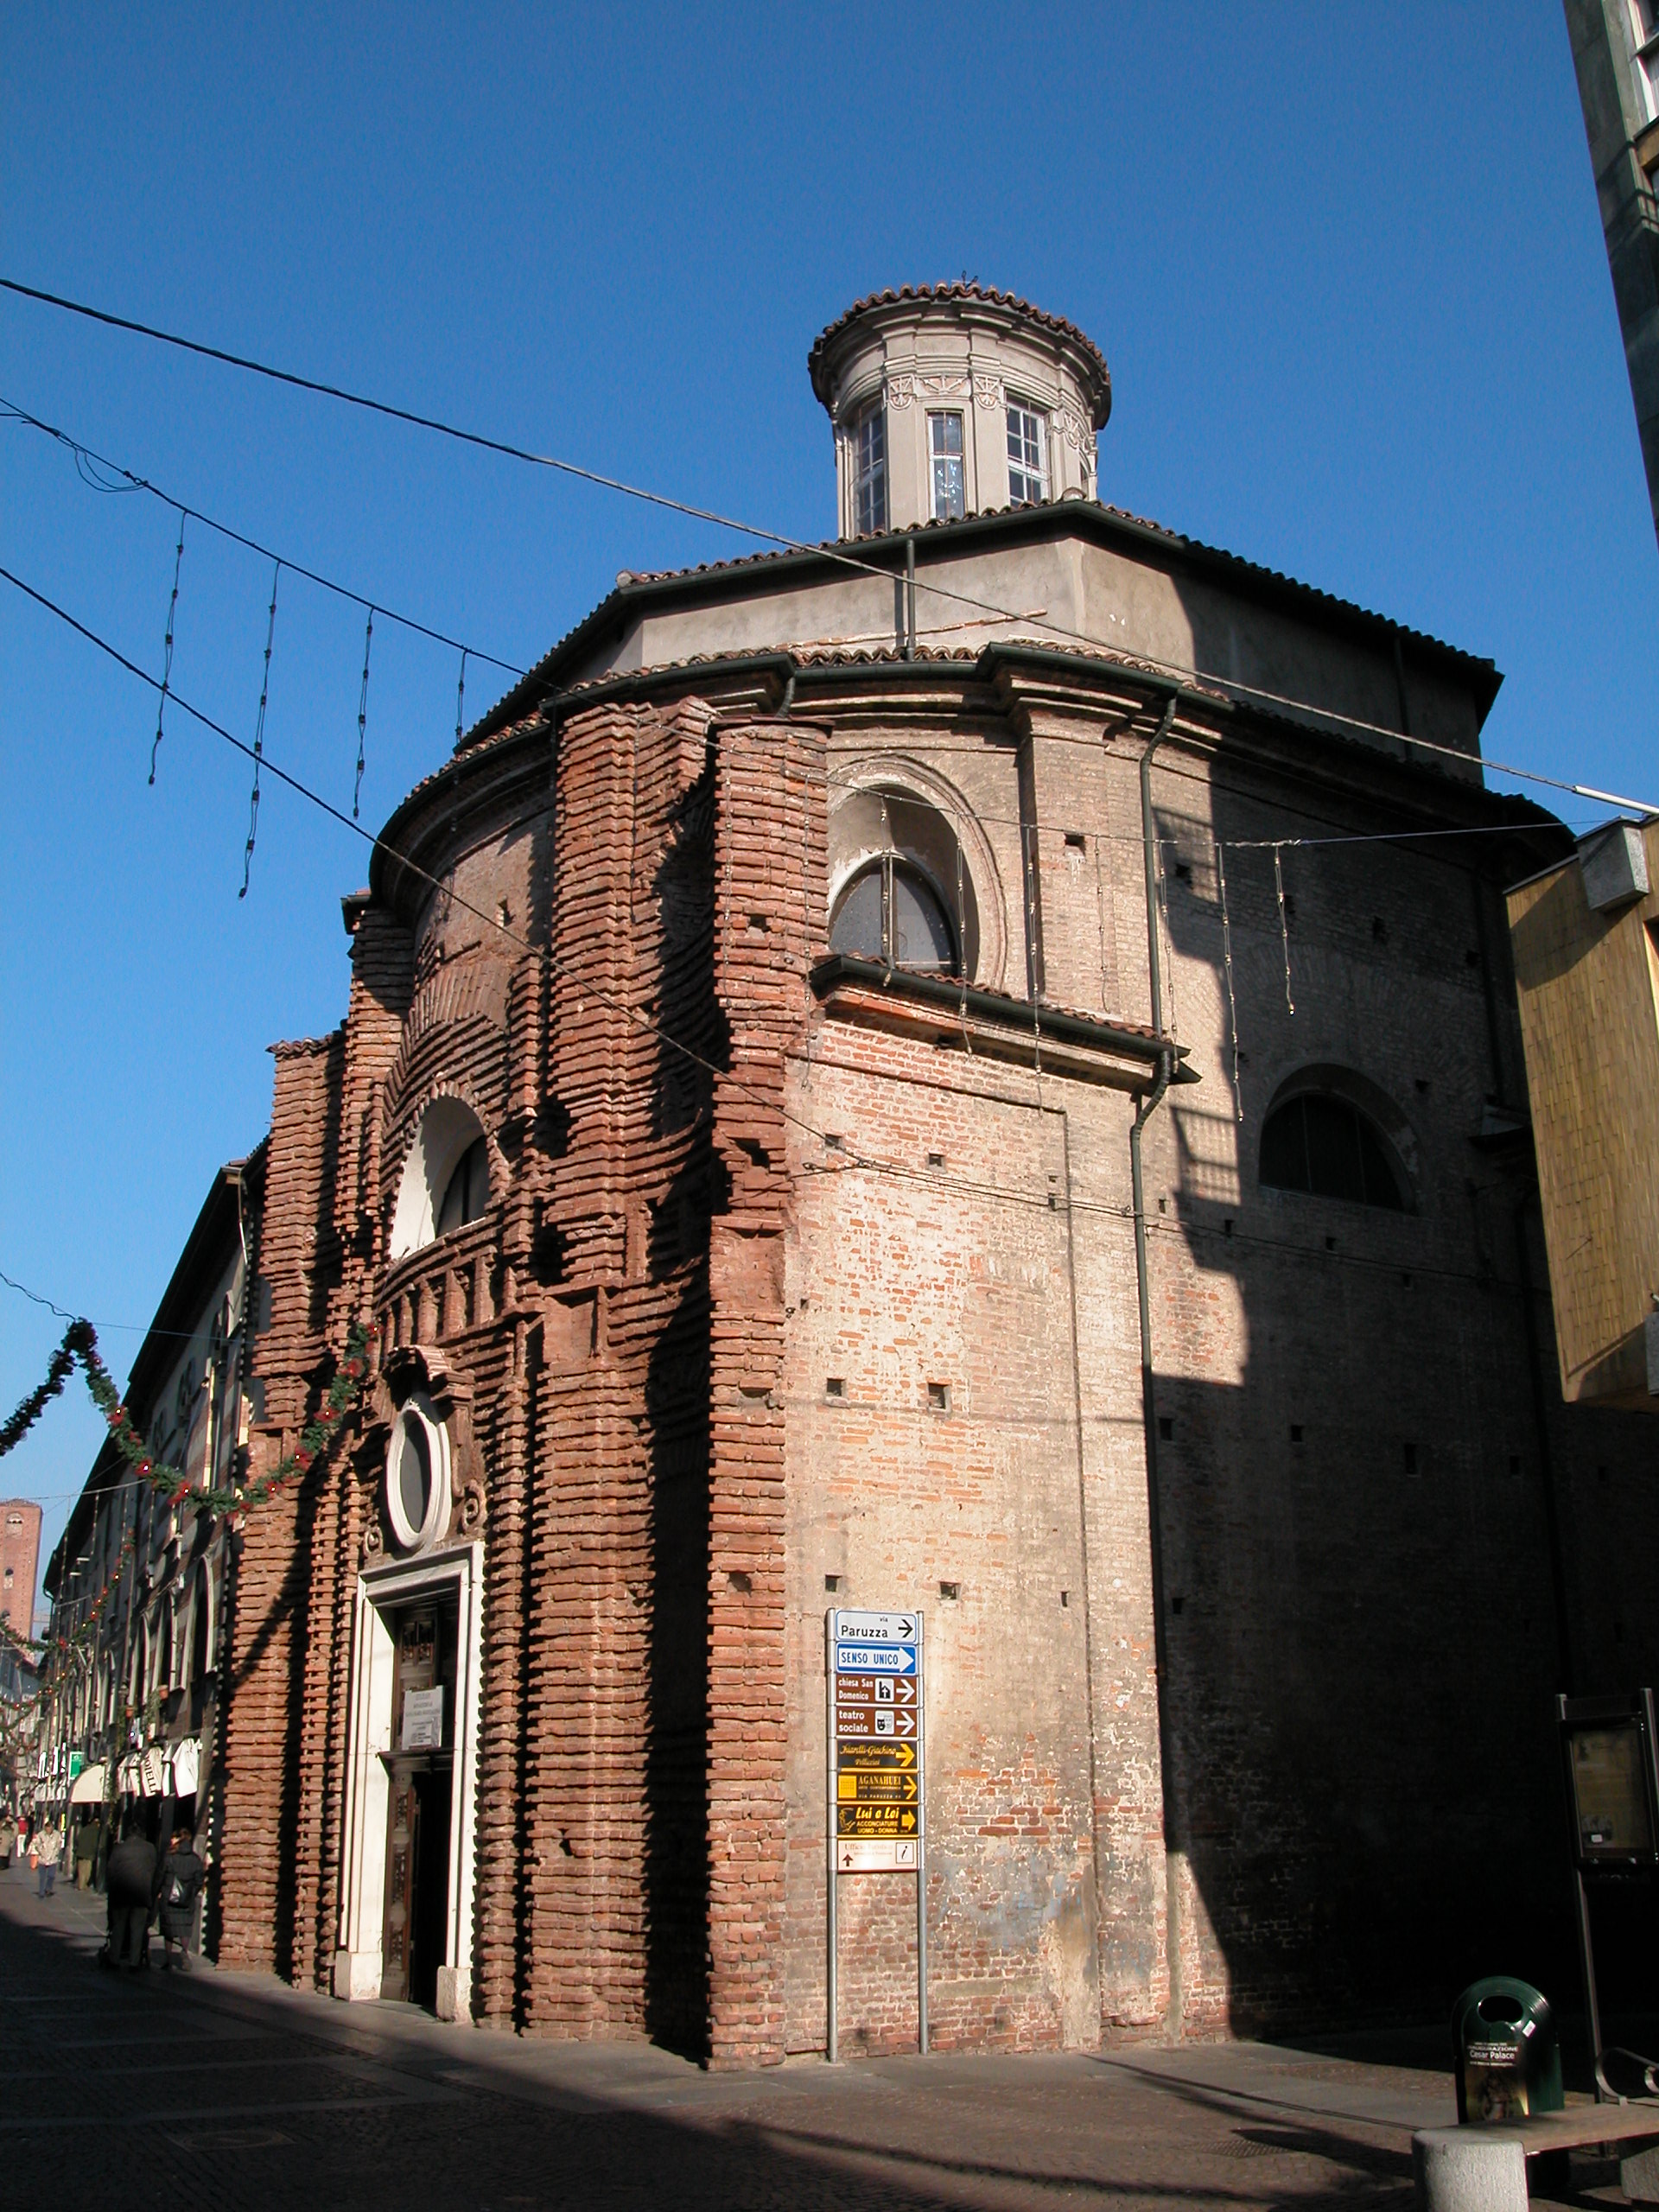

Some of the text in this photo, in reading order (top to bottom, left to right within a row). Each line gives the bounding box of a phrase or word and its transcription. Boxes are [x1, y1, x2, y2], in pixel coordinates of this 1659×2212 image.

[841, 1624, 888, 1638] Paruzza
[841, 1652, 899, 1665] SENSO UNICO
[838, 1678, 874, 1688] chiesa San
[838, 1691, 869, 1700] Domenico
[839, 1710, 865, 1720] teatro
[838, 1723, 868, 1733] sociale
[855, 1806, 873, 1819] Lui
[884, 1807, 899, 1819] Lei
[1490, 2050, 1515, 2059] Palace
